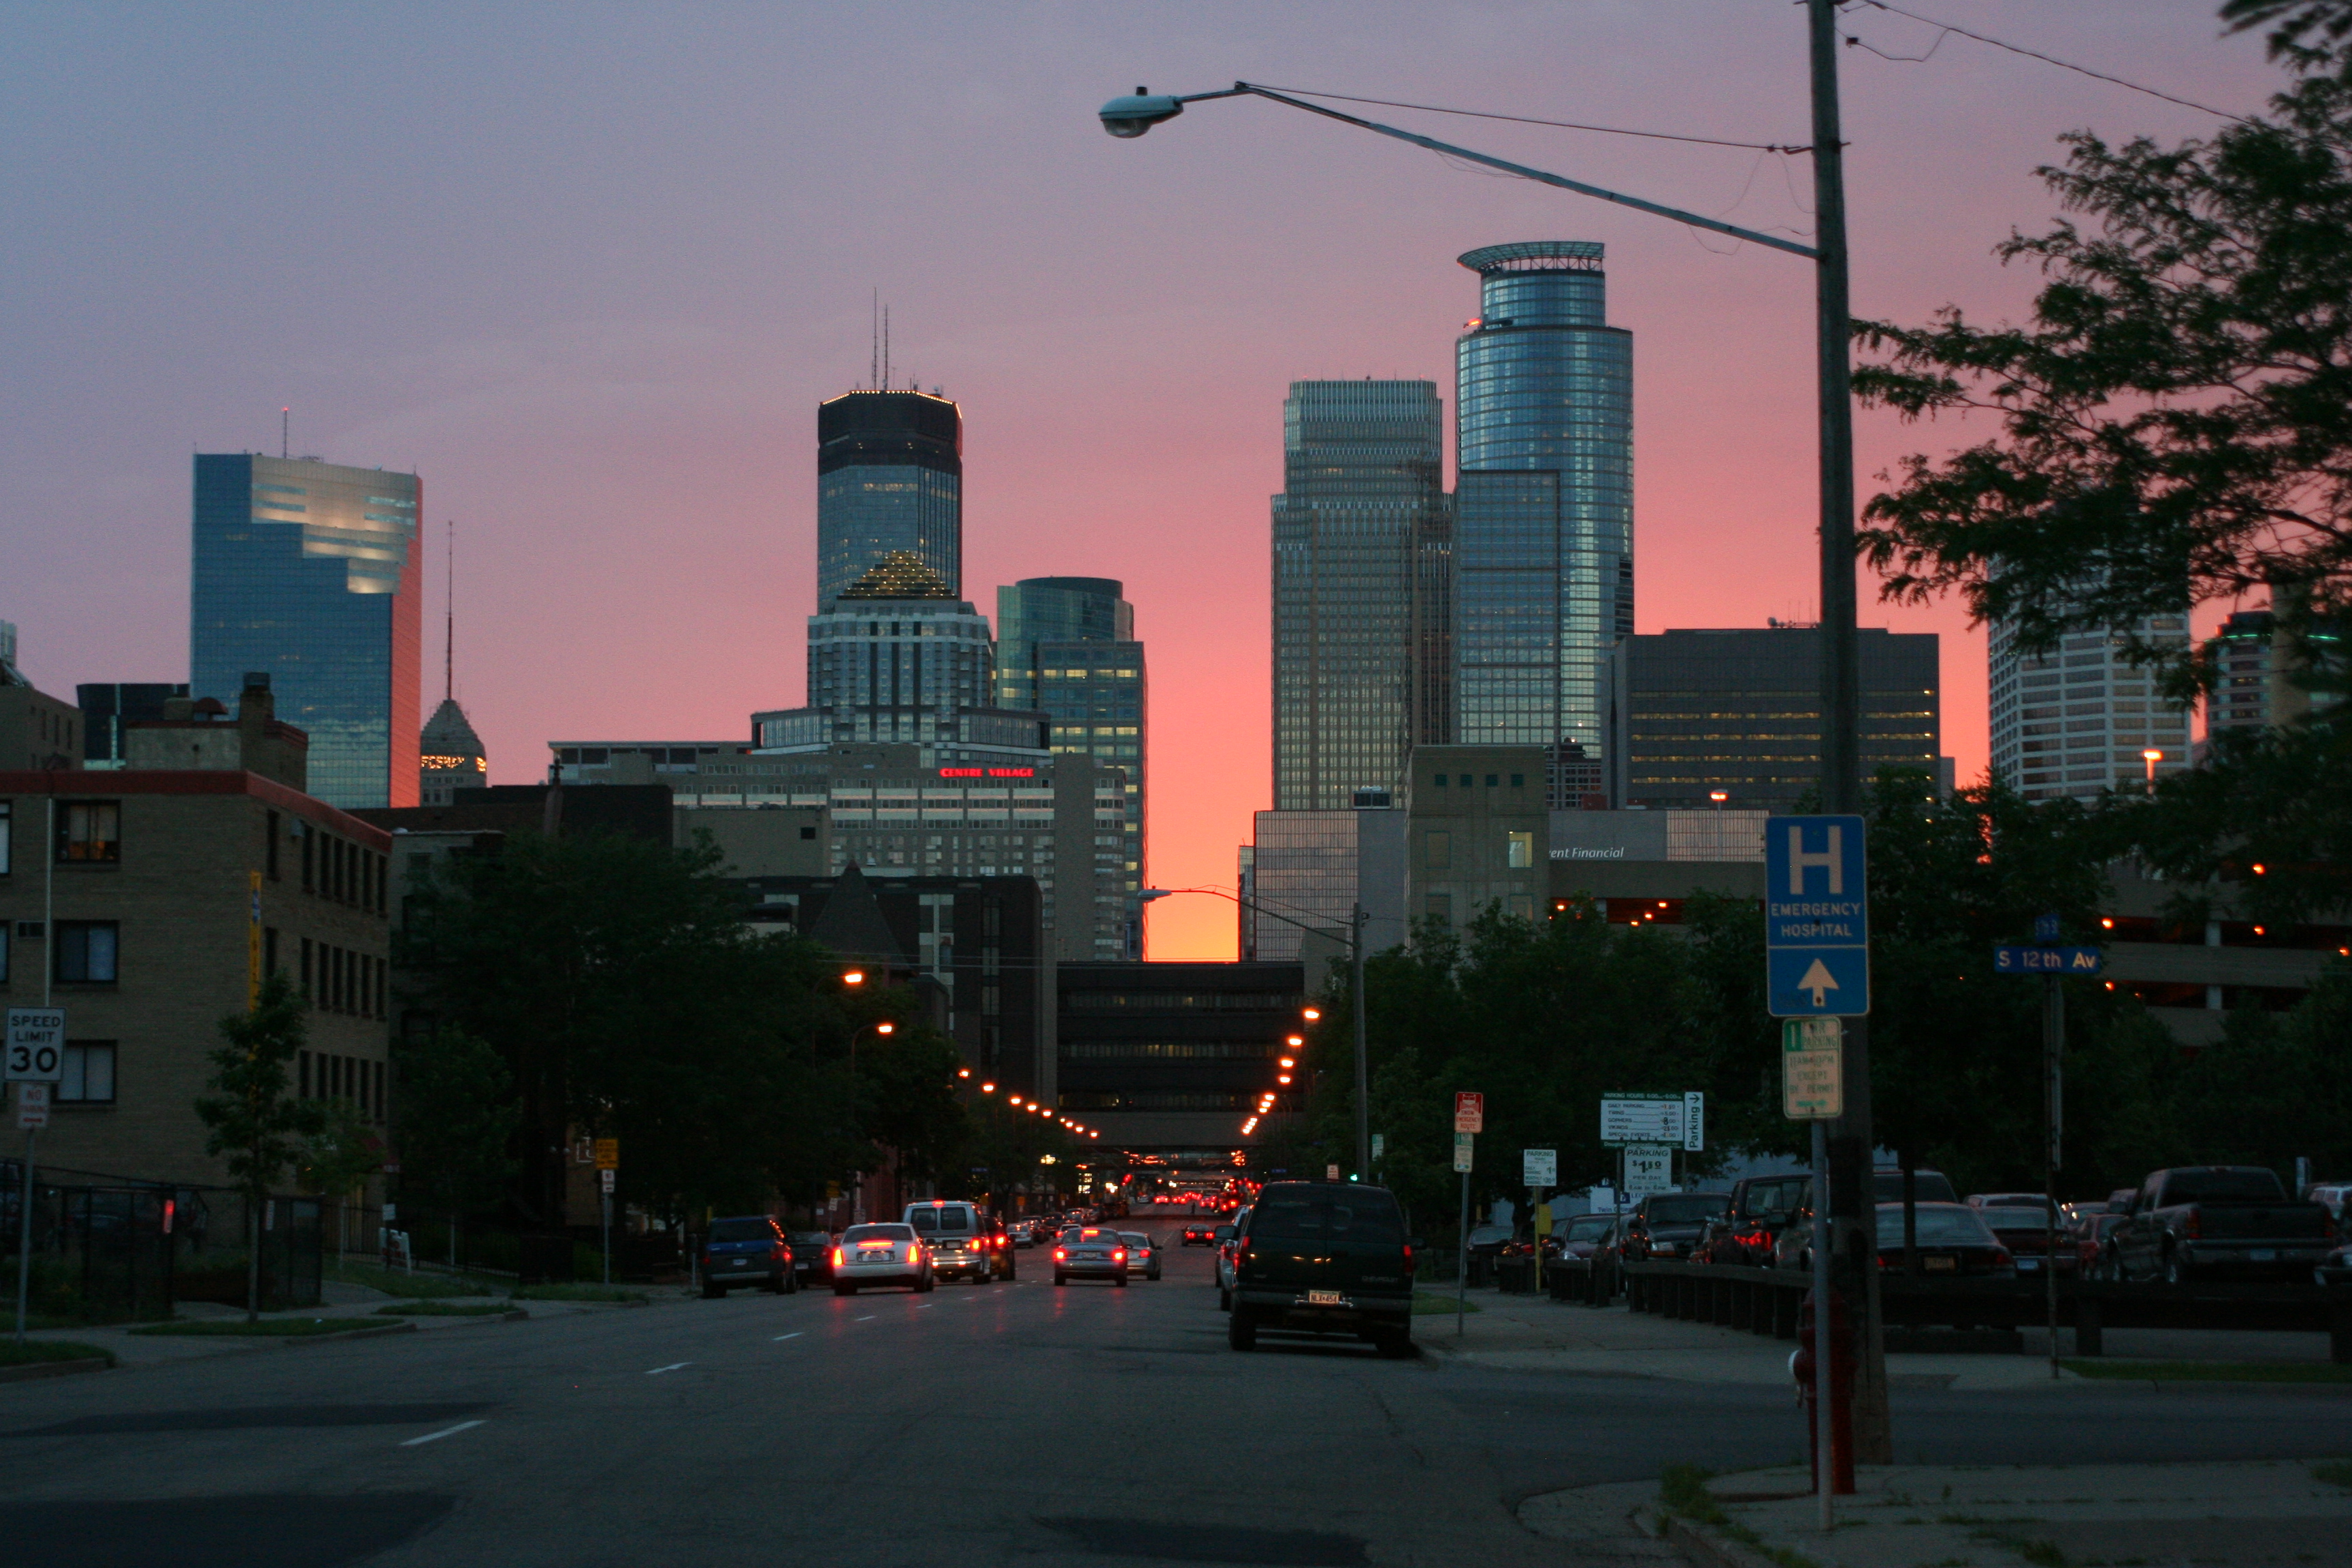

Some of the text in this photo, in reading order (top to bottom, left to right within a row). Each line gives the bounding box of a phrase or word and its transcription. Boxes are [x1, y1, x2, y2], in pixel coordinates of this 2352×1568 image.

[940, 768, 1034, 777] CENTRE VILLAGE
[1571, 847, 1624, 858] Financial
[1788, 825, 1843, 896] H
[1771, 902, 1861, 917] EMERGENCY
[1781, 923, 1853, 938] HOSPITAL
[1998, 950, 2097, 968] S 12th Av
[12, 1015, 61, 1028] SPEED
[15, 1031, 55, 1042] LIMIT
[1803, 1036, 1837, 1048] PARKING
[10, 1046, 57, 1073] 30
[1807, 1083, 1834, 1093] PERMIT
[27, 1090, 42, 1101] NO
[1689, 1107, 1700, 1148] Parking
